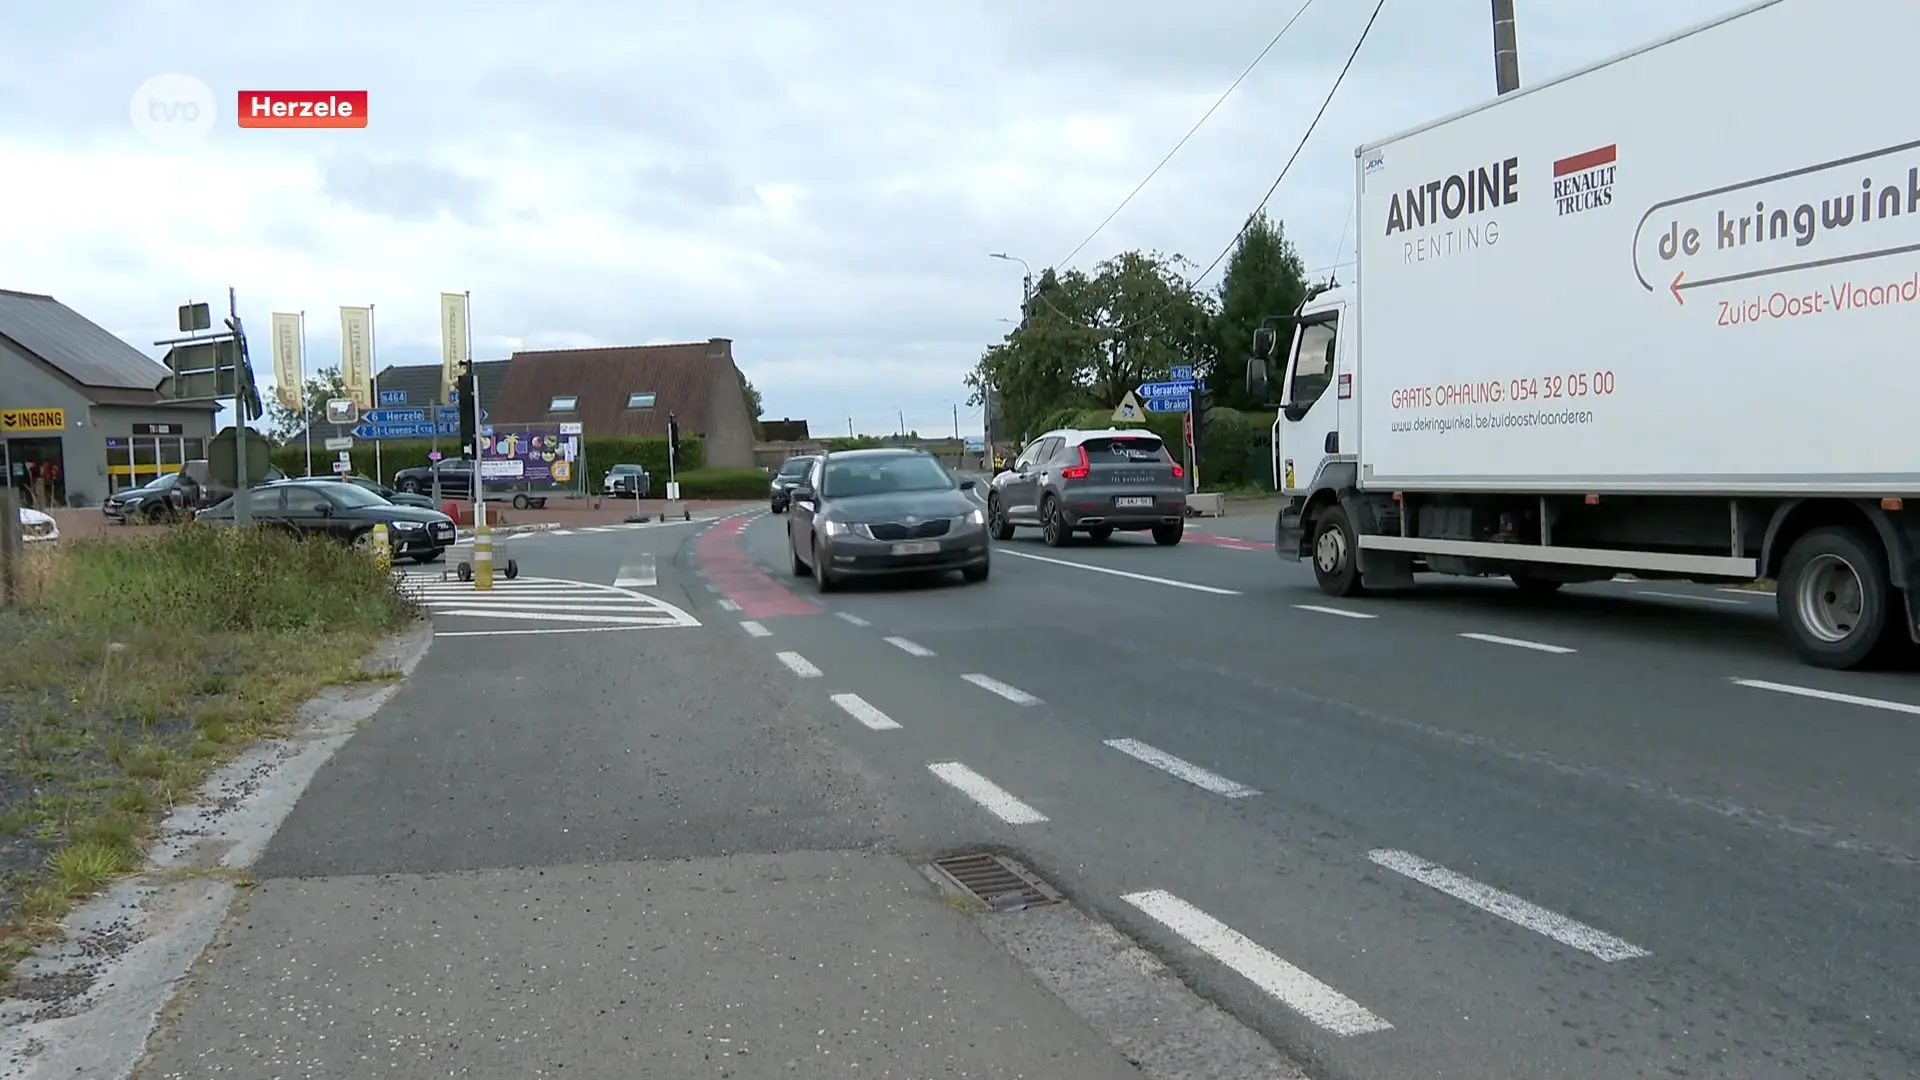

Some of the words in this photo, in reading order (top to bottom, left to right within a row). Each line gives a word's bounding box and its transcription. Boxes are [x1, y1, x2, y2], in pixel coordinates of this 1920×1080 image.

[1366, 154, 1385, 170] JDK
[1385, 156, 1519, 236] ANTOINE
[1553, 165, 1617, 200] RENAULT
[1556, 187, 1613, 216] TRUCKS
[1404, 221, 1500, 264] RENTING
[1658, 221, 1701, 261] de
[1391, 387, 1432, 409] GRATIS
[1435, 381, 1506, 406] OPHALING:
[1510, 378, 1538, 400] 054
[1543, 375, 1562, 398] 32
[1567, 373, 1588, 397] 05
[1593, 371, 1615, 395] 00
[372, 412, 378, 421] 6
[386, 410, 423, 421] Herzele
[1153, 400, 1159, 410] 11
[1164, 399, 1188, 410] Brakel
[18, 412, 62, 427] INGANG
[361, 426, 367, 436] 2
[1392, 409, 1593, 434] www.dekringwinkel.be/zuidoostvlaanderen
